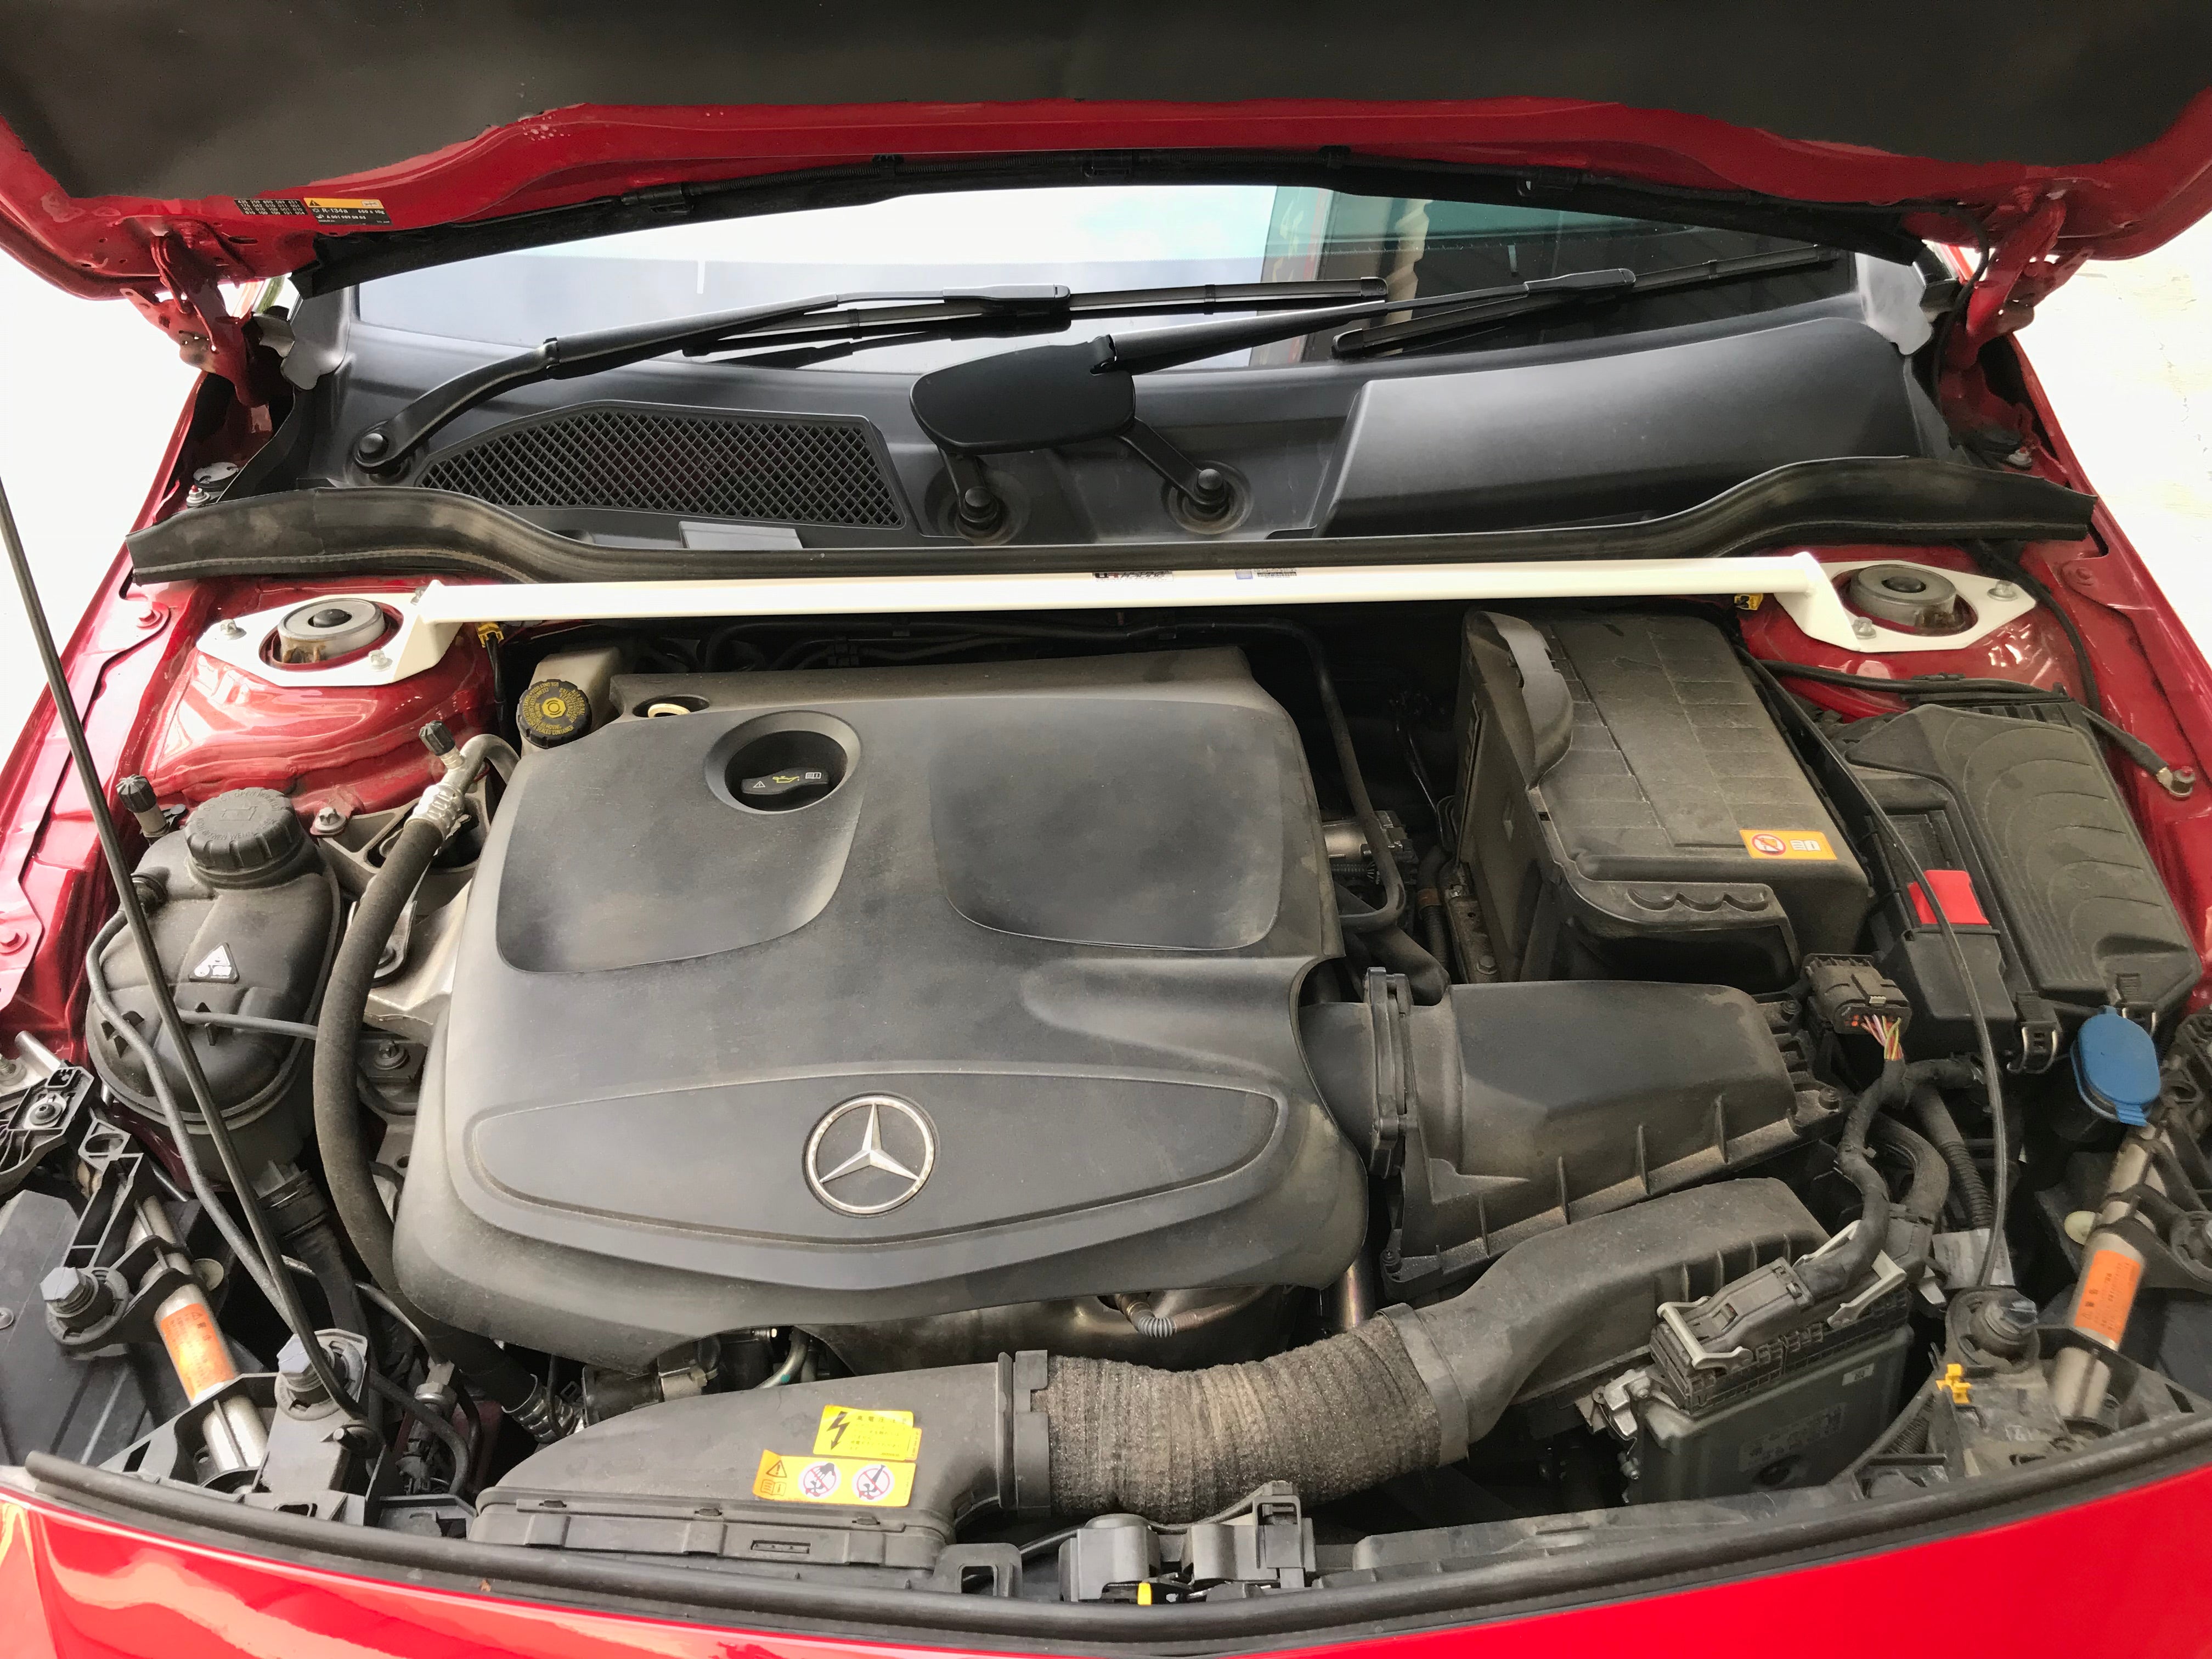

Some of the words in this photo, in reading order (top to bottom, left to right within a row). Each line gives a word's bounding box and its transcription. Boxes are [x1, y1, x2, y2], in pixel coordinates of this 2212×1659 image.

[536, 687, 549, 696] CLEAN
[552, 725, 574, 735] CONTAINER
[234, 789, 257, 798] OPEN
